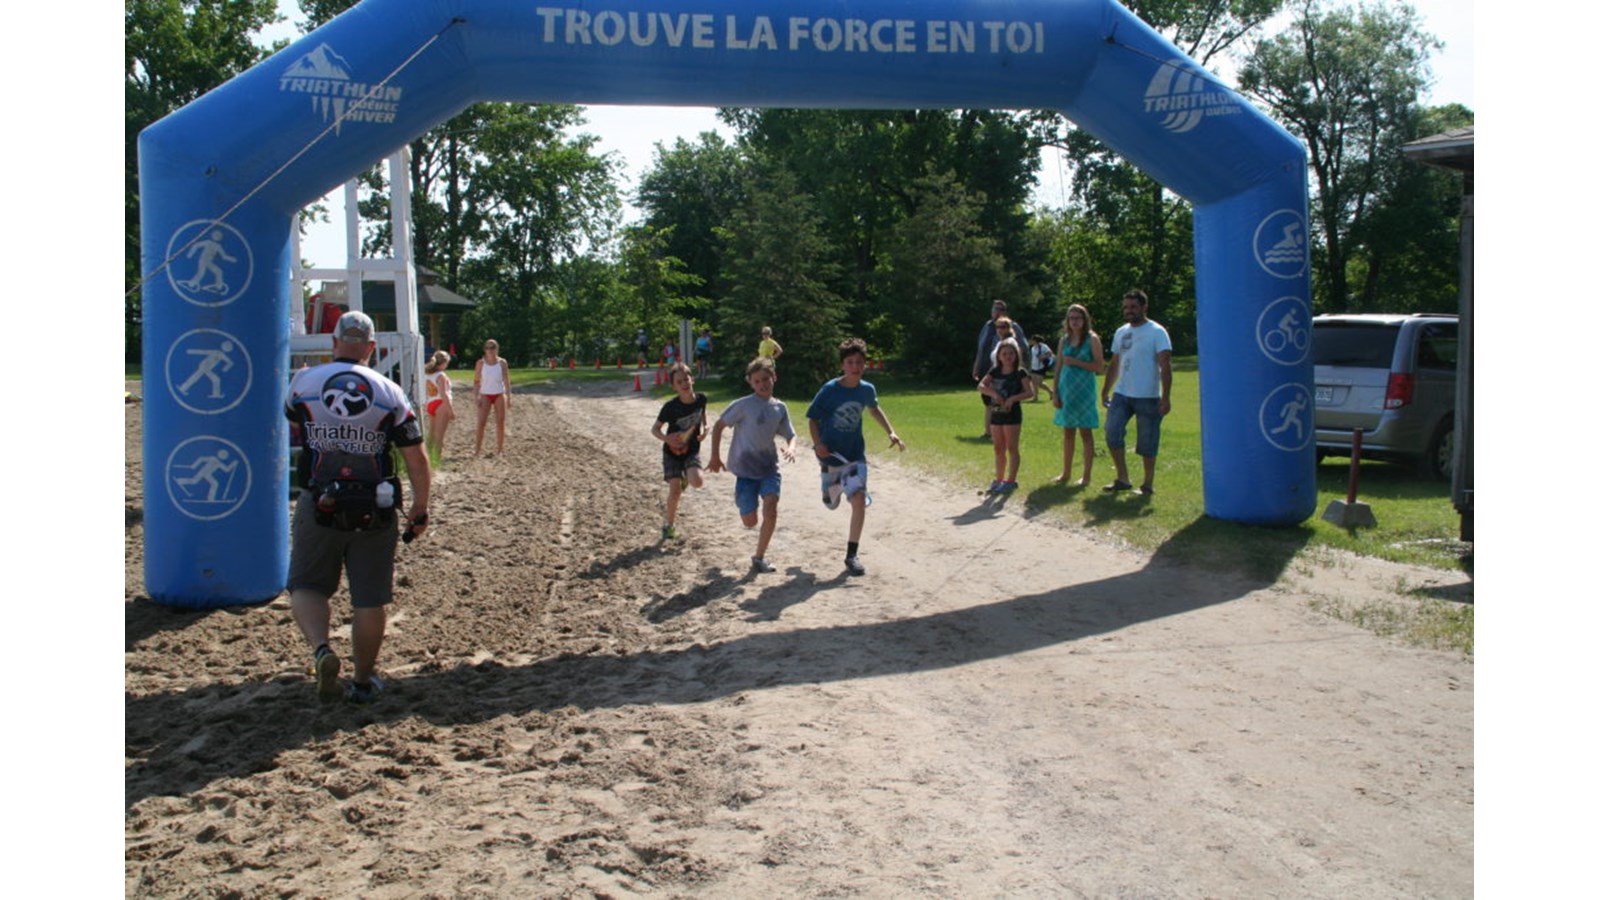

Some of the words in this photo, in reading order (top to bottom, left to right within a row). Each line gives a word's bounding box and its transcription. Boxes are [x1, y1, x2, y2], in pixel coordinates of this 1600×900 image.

[536, 7, 715, 47] TROUVE
[726, 15, 777, 49] LA
[788, 17, 916, 52] FORCE
[927, 20, 975, 53] EN
[983, 21, 1044, 54] TOI
[280, 79, 401, 100] TRIATHLON
[346, 110, 395, 123] HIVER
[305, 422, 386, 444] Triathlon
